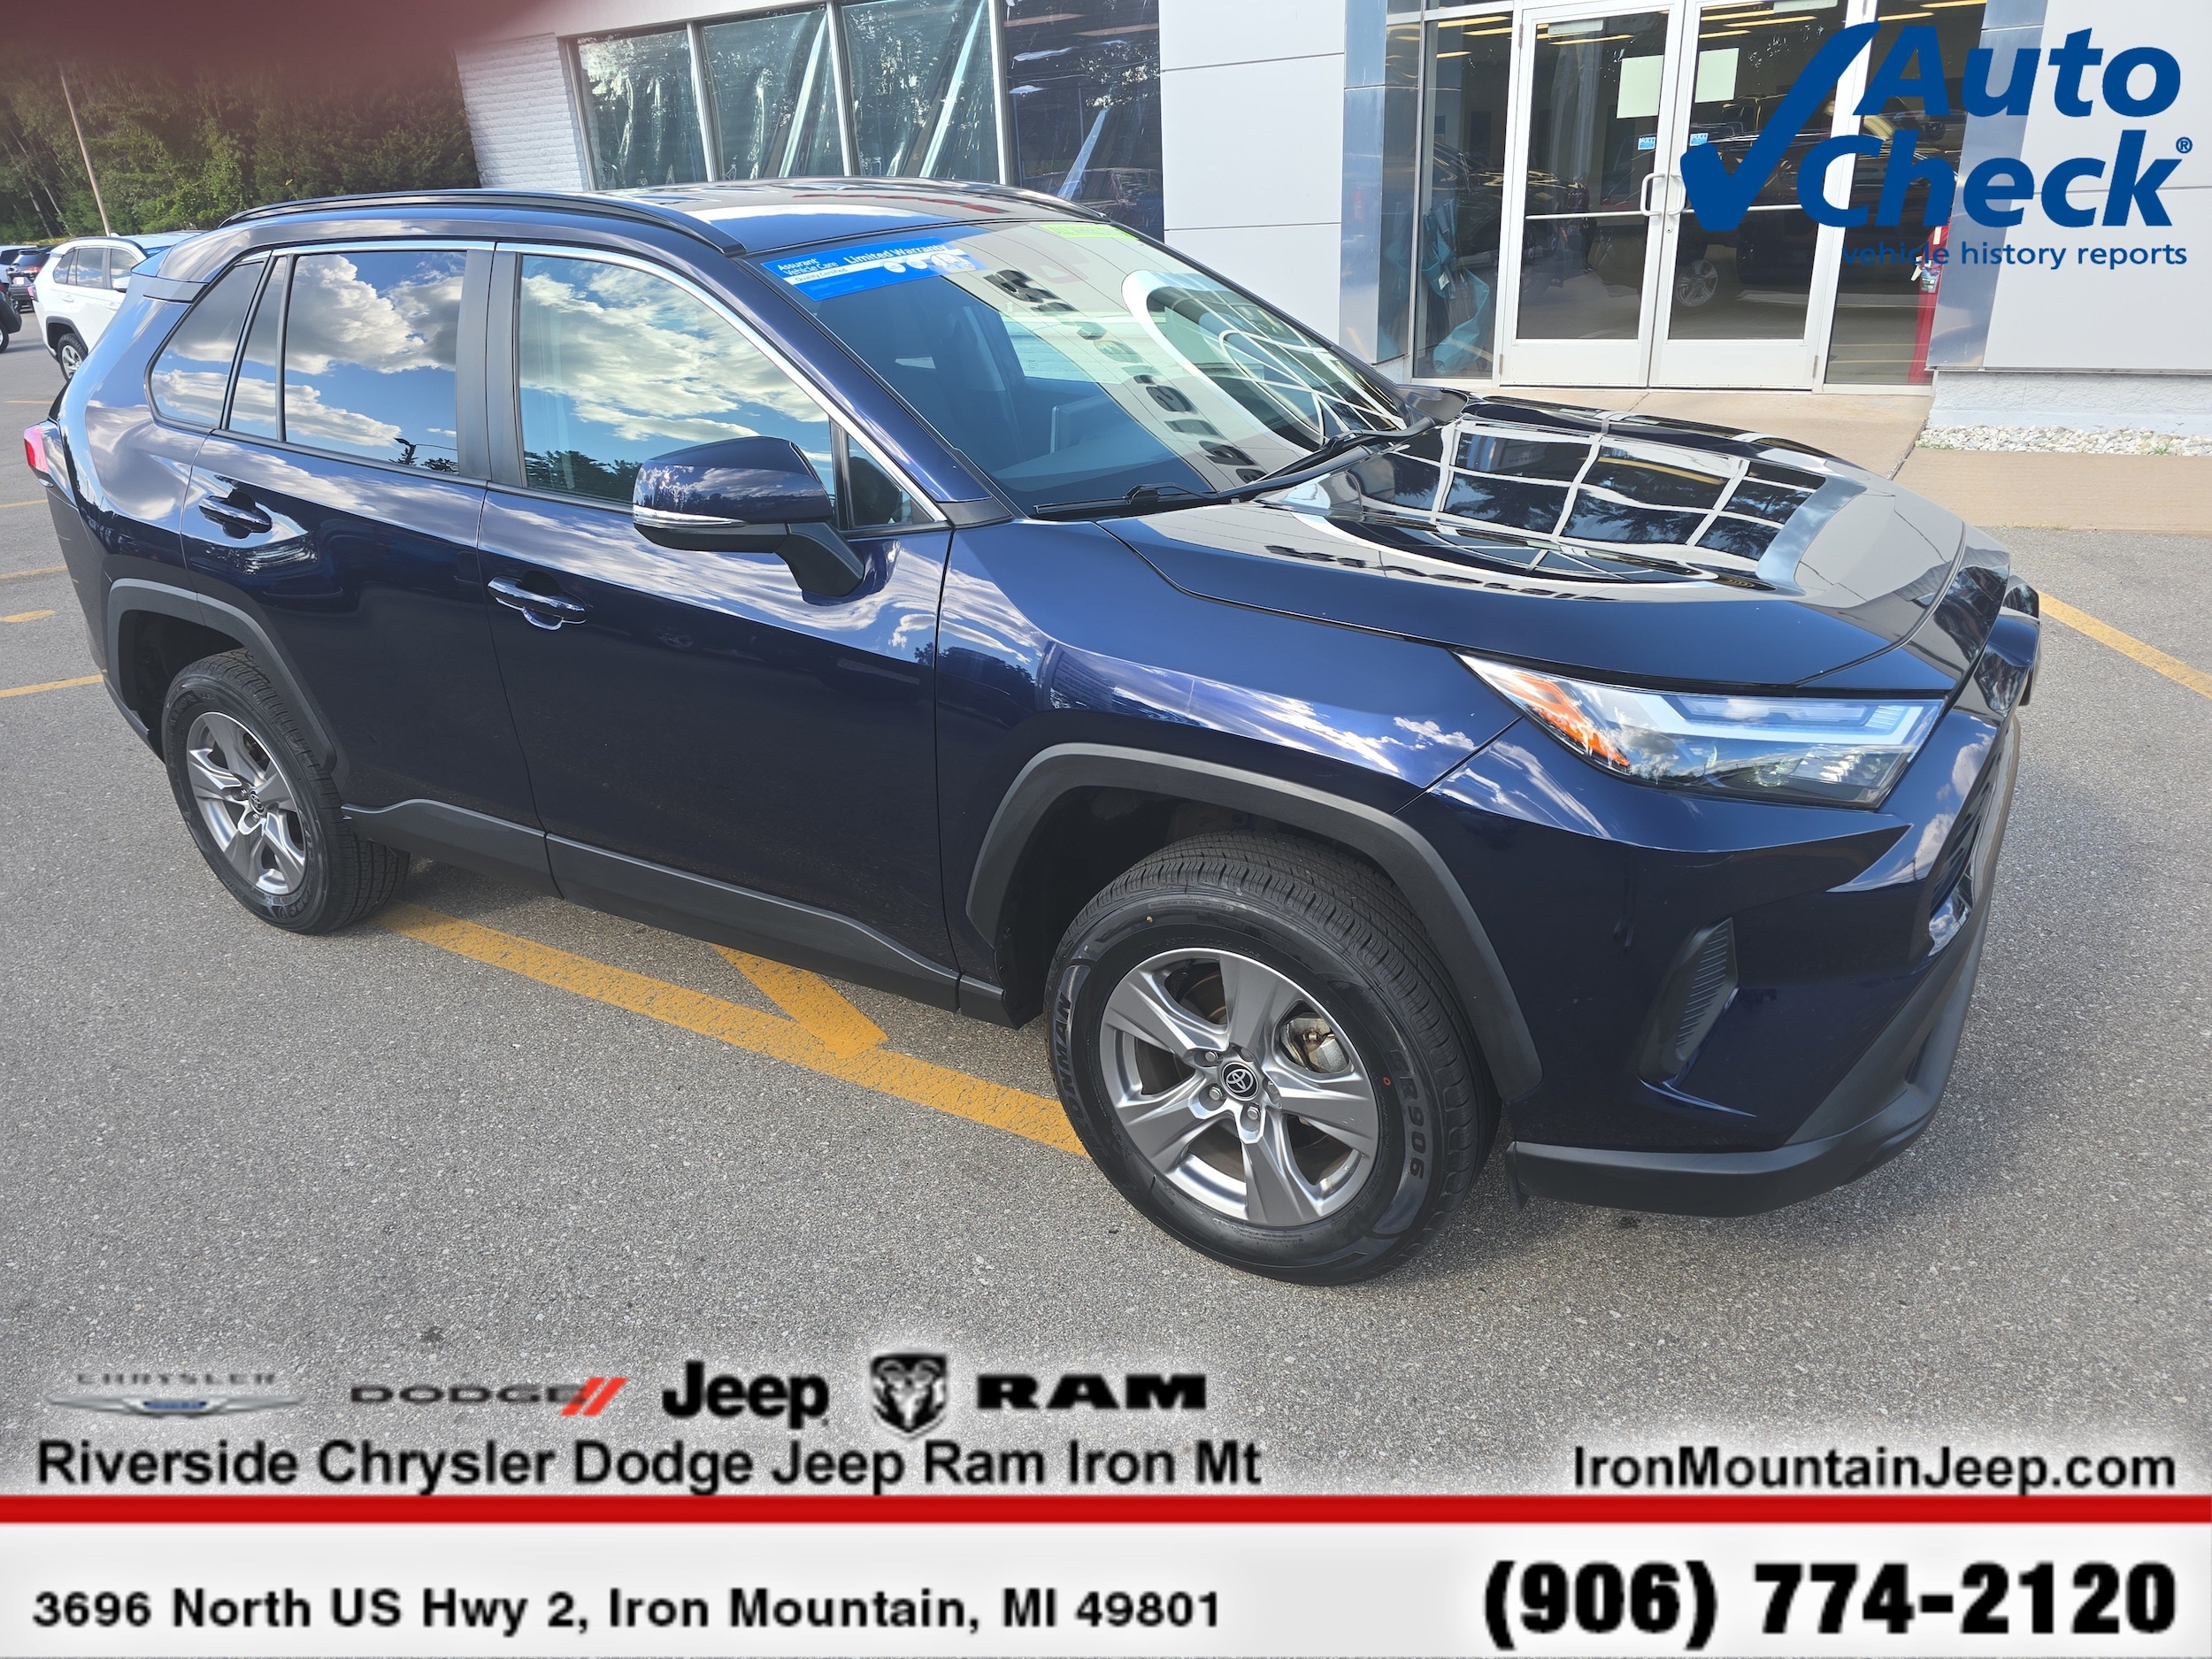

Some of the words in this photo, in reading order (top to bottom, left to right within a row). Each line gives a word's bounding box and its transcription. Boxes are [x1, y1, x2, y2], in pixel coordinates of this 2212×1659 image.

[843, 250, 891, 265] Limited
[890, 244, 947, 257] Warranty
[818, 261, 839, 272] Care
